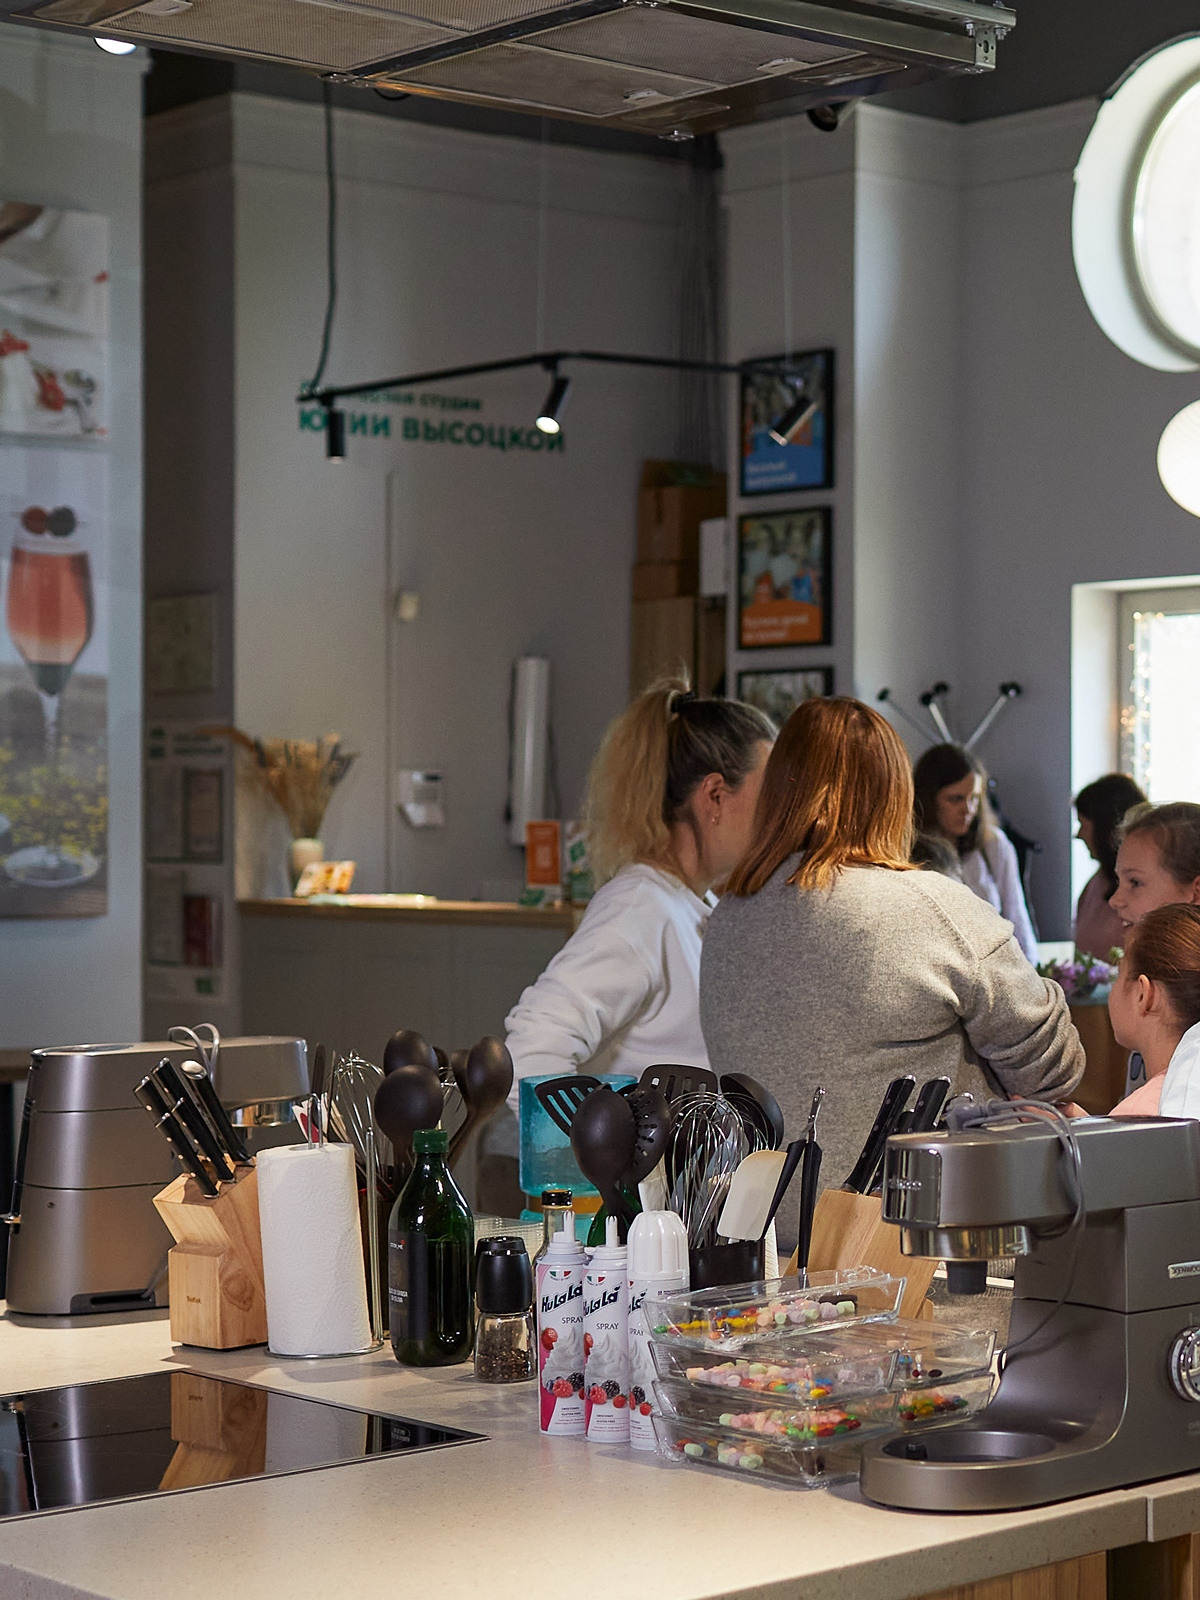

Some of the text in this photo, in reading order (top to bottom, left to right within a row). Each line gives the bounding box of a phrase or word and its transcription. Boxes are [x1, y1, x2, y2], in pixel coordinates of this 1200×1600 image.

[299, 406, 391, 438] ЮИИ
[596, 1322, 620, 1330] SPRAY
[629, 1327, 644, 1336] PRAY
